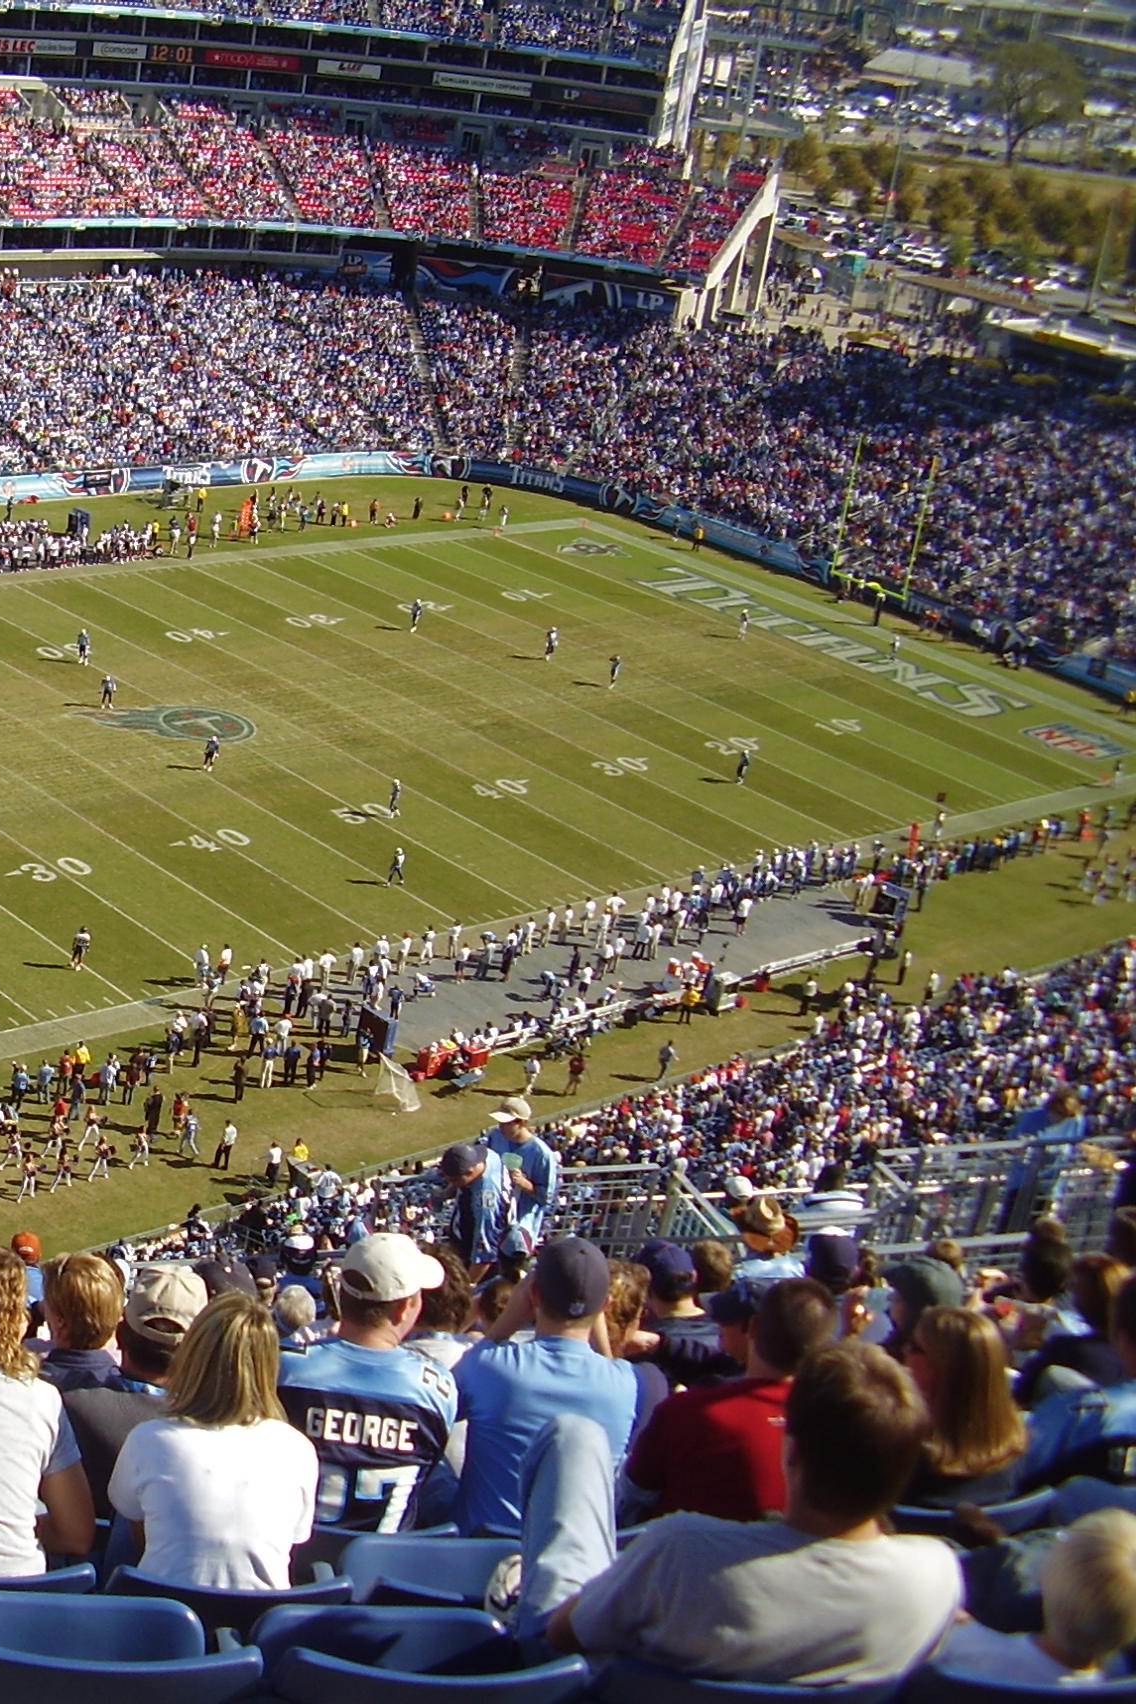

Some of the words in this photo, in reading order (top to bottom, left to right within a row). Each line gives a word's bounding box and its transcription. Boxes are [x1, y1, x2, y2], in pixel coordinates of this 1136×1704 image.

[12, 40, 35, 52] LEC
[151, 45, 192, 63] 12:01
[563, 89, 580, 100] LP
[636, 291, 664, 310] LP
[1034, 728, 1097, 758] NFL
[591, 757, 648, 777] 30
[472, 779, 528, 799] 40
[189, 829, 251, 852] 40
[20, 857, 92, 882] 30
[306, 1407, 419, 1451] GEORGE
